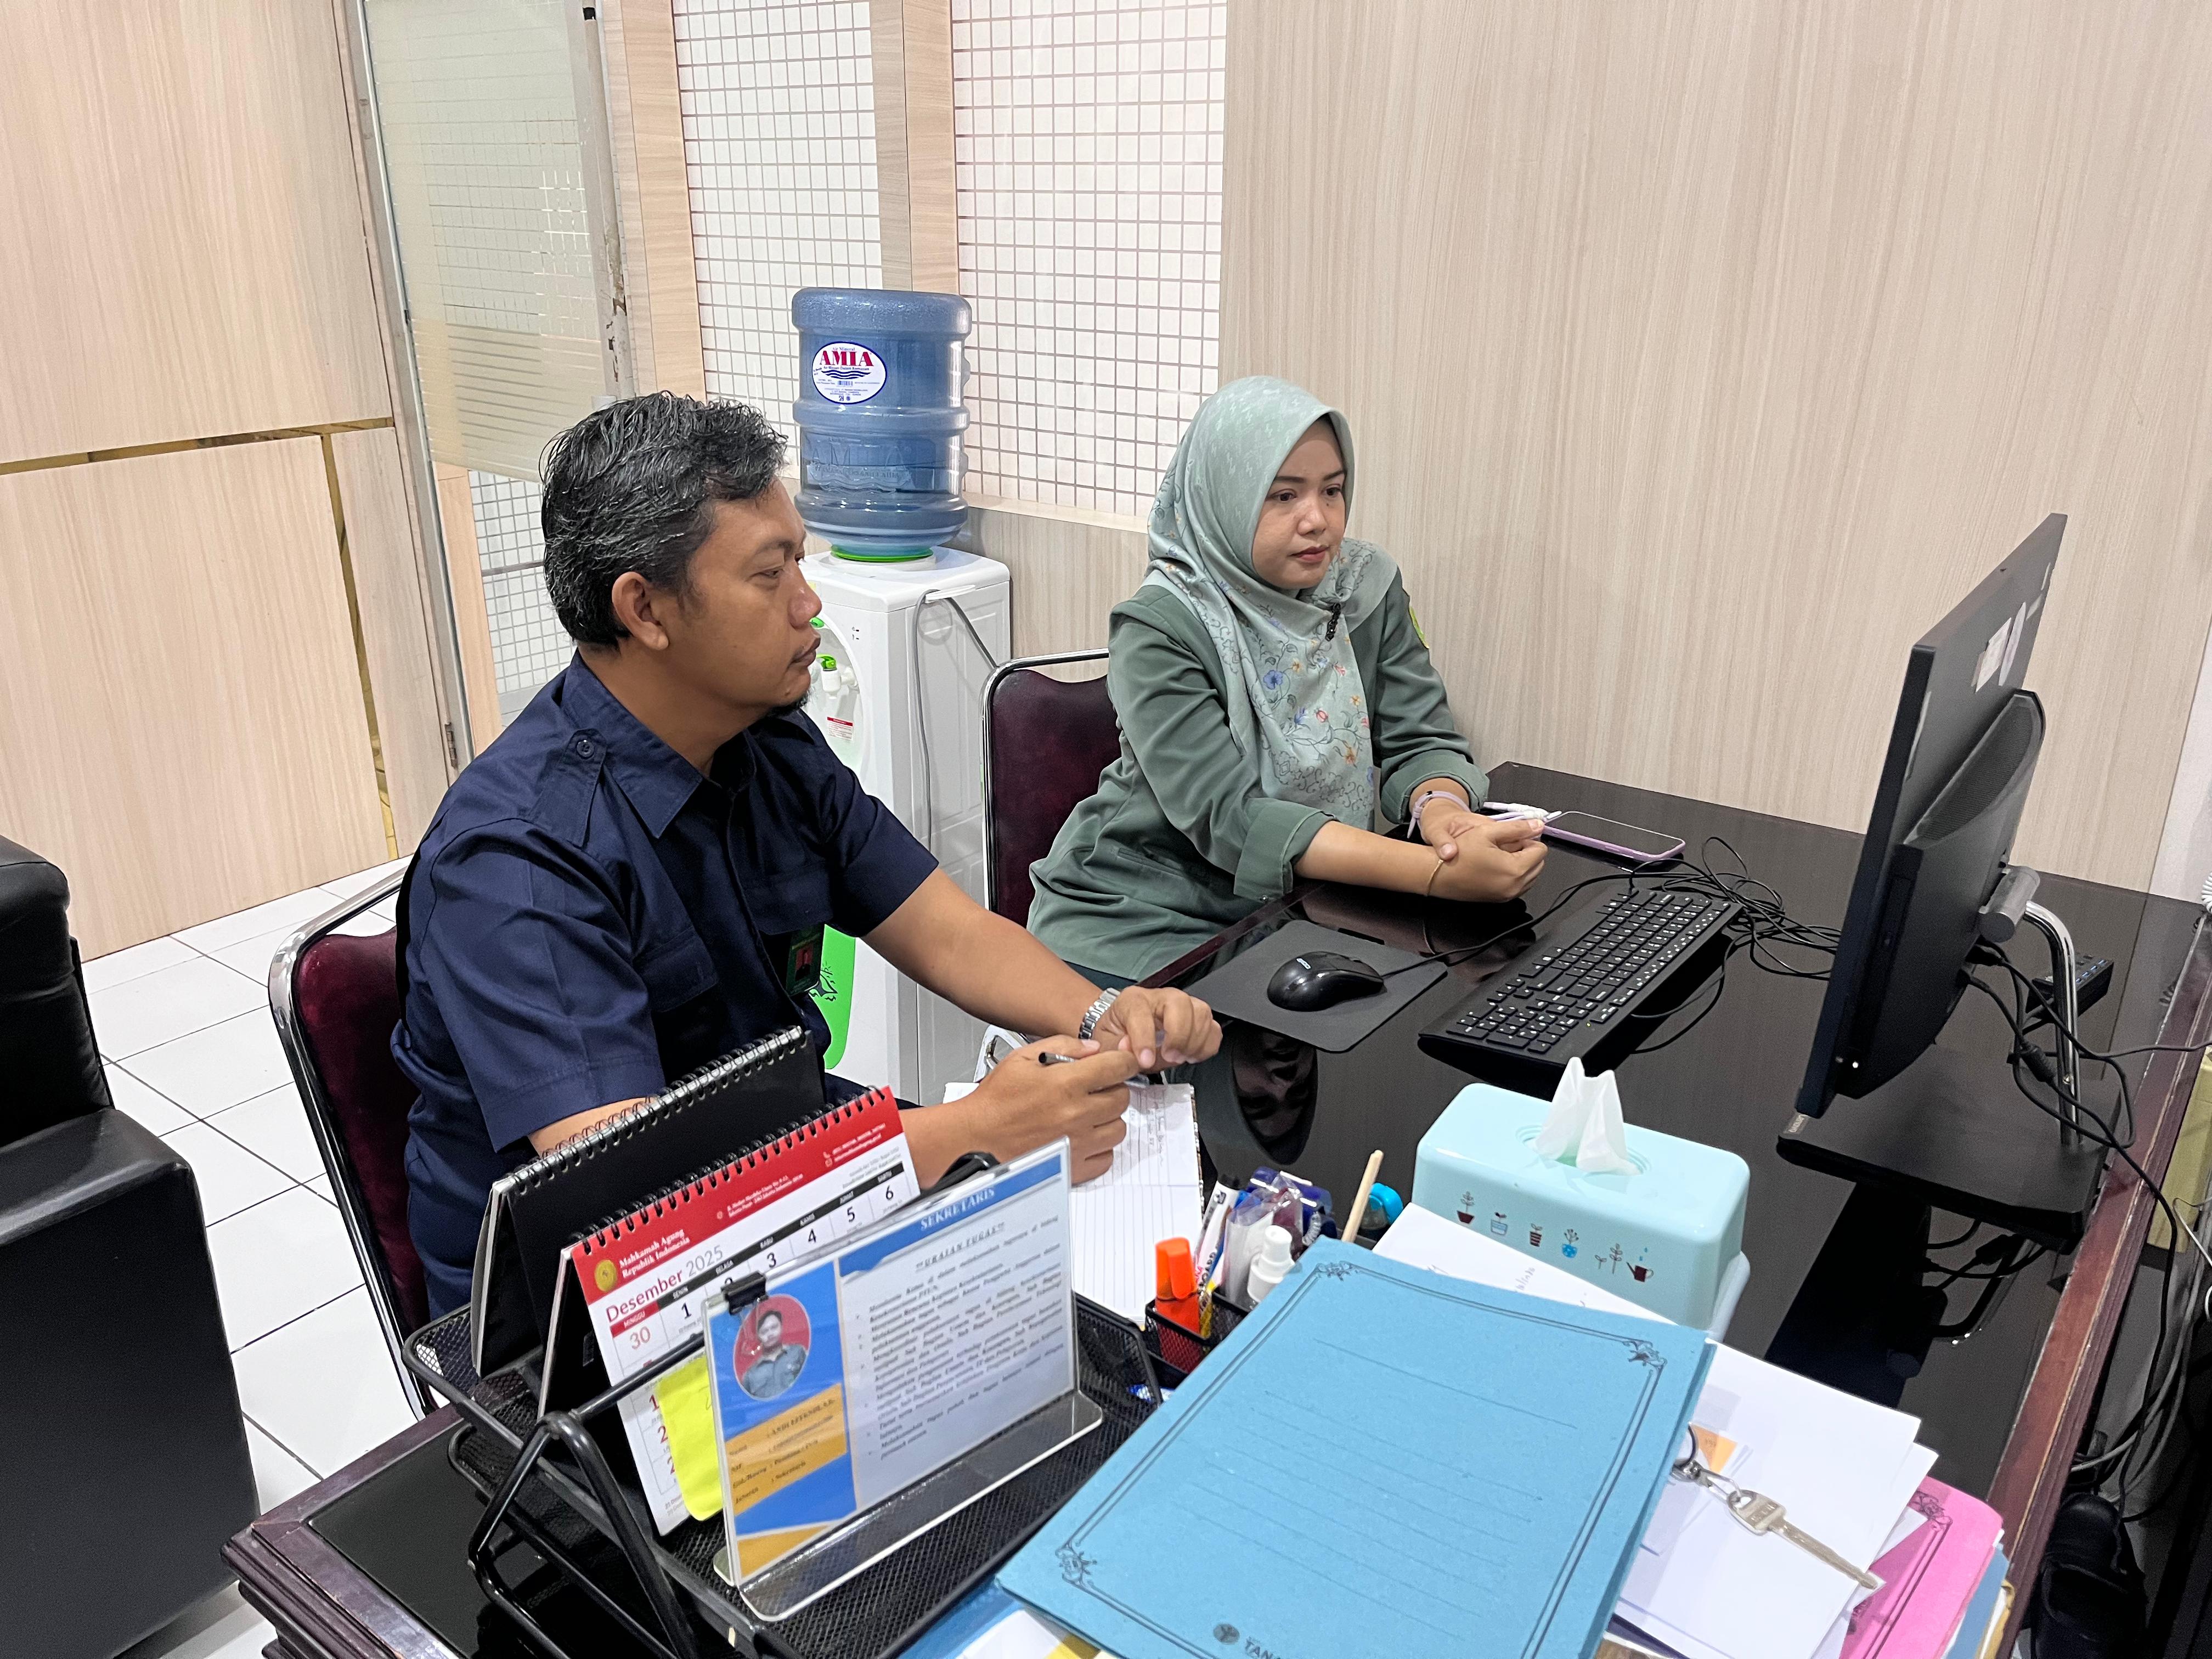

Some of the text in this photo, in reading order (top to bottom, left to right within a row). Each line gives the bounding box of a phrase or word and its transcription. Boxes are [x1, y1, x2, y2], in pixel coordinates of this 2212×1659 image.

[820, 350, 874, 366] AMIA
[921, 1188, 995, 1231] SEKRETARIS
[619, 1229, 685, 1268] Mahkamah Agung
[622, 1237, 690, 1278] Republik Indonesia
[630, 1185, 894, 1350] 30 1 3 4 5 6
[606, 1245, 723, 1322] Desember 2025
